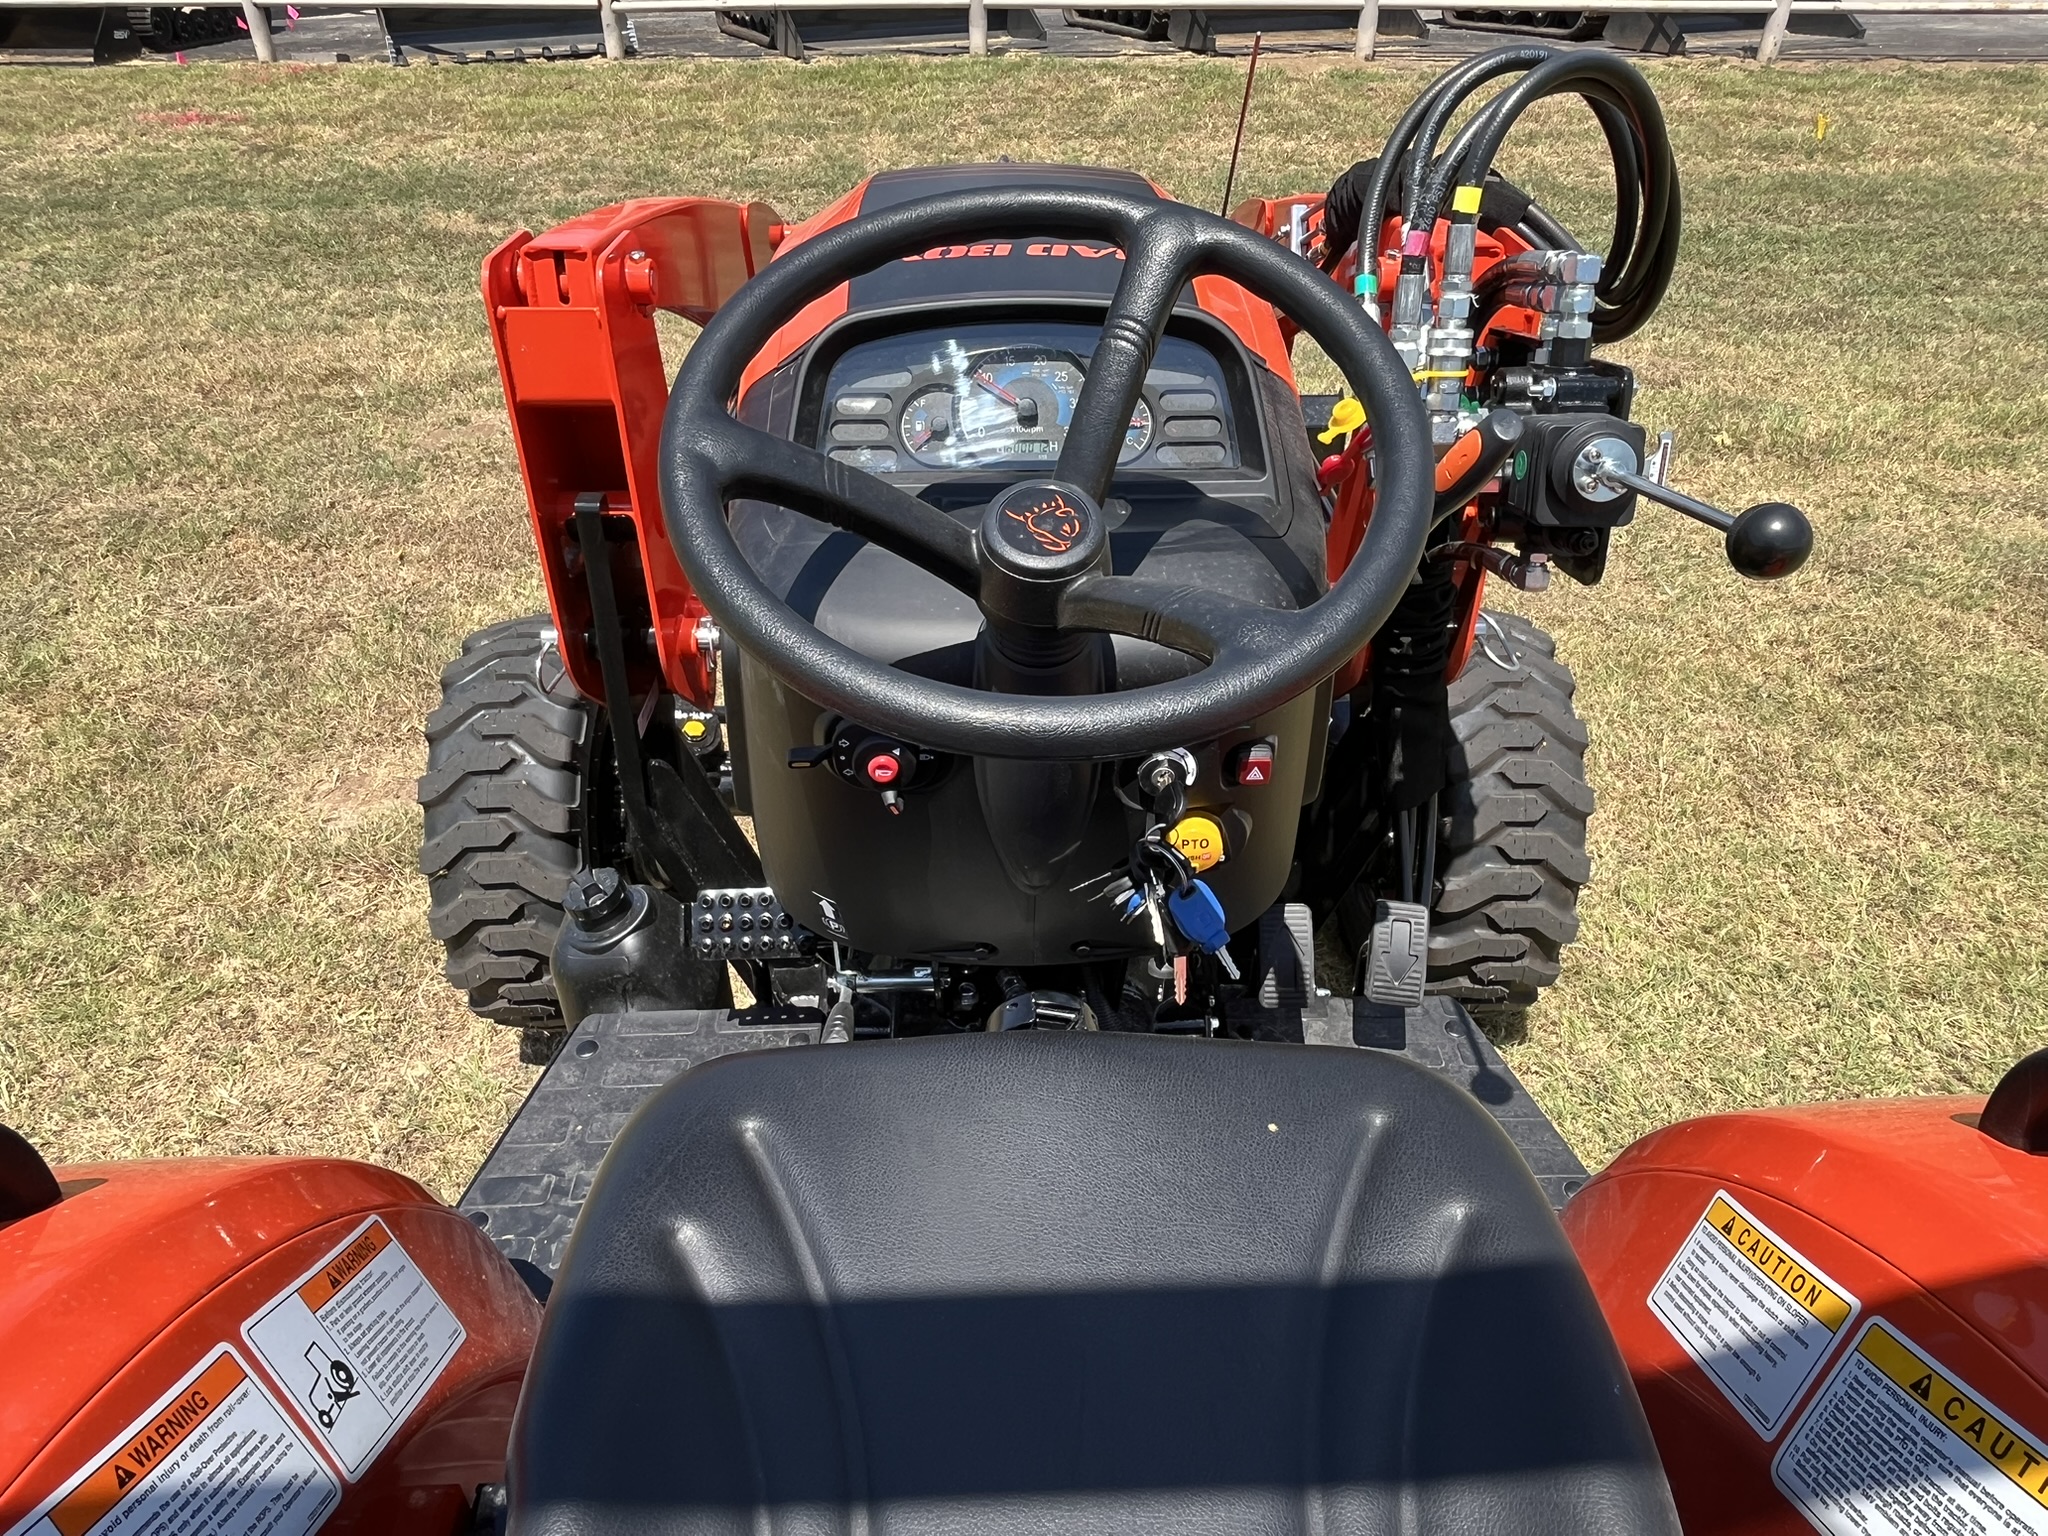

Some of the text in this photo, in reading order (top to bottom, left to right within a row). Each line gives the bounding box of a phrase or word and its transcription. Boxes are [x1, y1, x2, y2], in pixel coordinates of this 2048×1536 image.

[1004, 356, 1016, 367] 15
[1033, 355, 1048, 366] 20
[1054, 371, 1069, 382] 25
[919, 398, 926, 407] F
[1069, 397, 1079, 409] 3
[977, 426, 986, 437] 0
[1126, 435, 1135, 445] C
[1181, 838, 1210, 850] PTO
[331, 1234, 377, 1282] WARNING
[1735, 1226, 1823, 1308] CAUTION
[1853, 1358, 1864, 1370] TO
[1881, 1382, 1920, 1418] PERSONAL
[1917, 1413, 1948, 1443] INJURY:
[126, 1388, 210, 1471] WARNING
[189, 1452, 215, 1481] Roll-Over
[212, 1429, 238, 1457] Protective
[1893, 1434, 1909, 1450] PTO
[1914, 1452, 1931, 1470] OFF.
[120, 1479, 159, 1520] personal
[156, 1457, 182, 1484] injury
[179, 1449, 190, 1461] or
[186, 1429, 209, 1453] death
[206, 1414, 224, 1433] from
[1872, 1488, 1893, 1511] rough
[1897, 1487, 1915, 1506] stay
[1953, 1462, 1981, 1489] manual
[1979, 1484, 2006, 1510] before
[1953, 1474, 1969, 1491] that
[1966, 1489, 2002, 1523] everyone
[1885, 1488, 1915, 1520] together
[1922, 1498, 1942, 1518] bolts
[1924, 1473, 1948, 1498] tractor
[1953, 1502, 1969, 1520] any
[1968, 1513, 1989, 1535] time.
[1930, 1492, 1944, 1507] the
[1941, 1503, 1969, 1532] tractor,
[1844, 1508, 1862, 1529] lower
